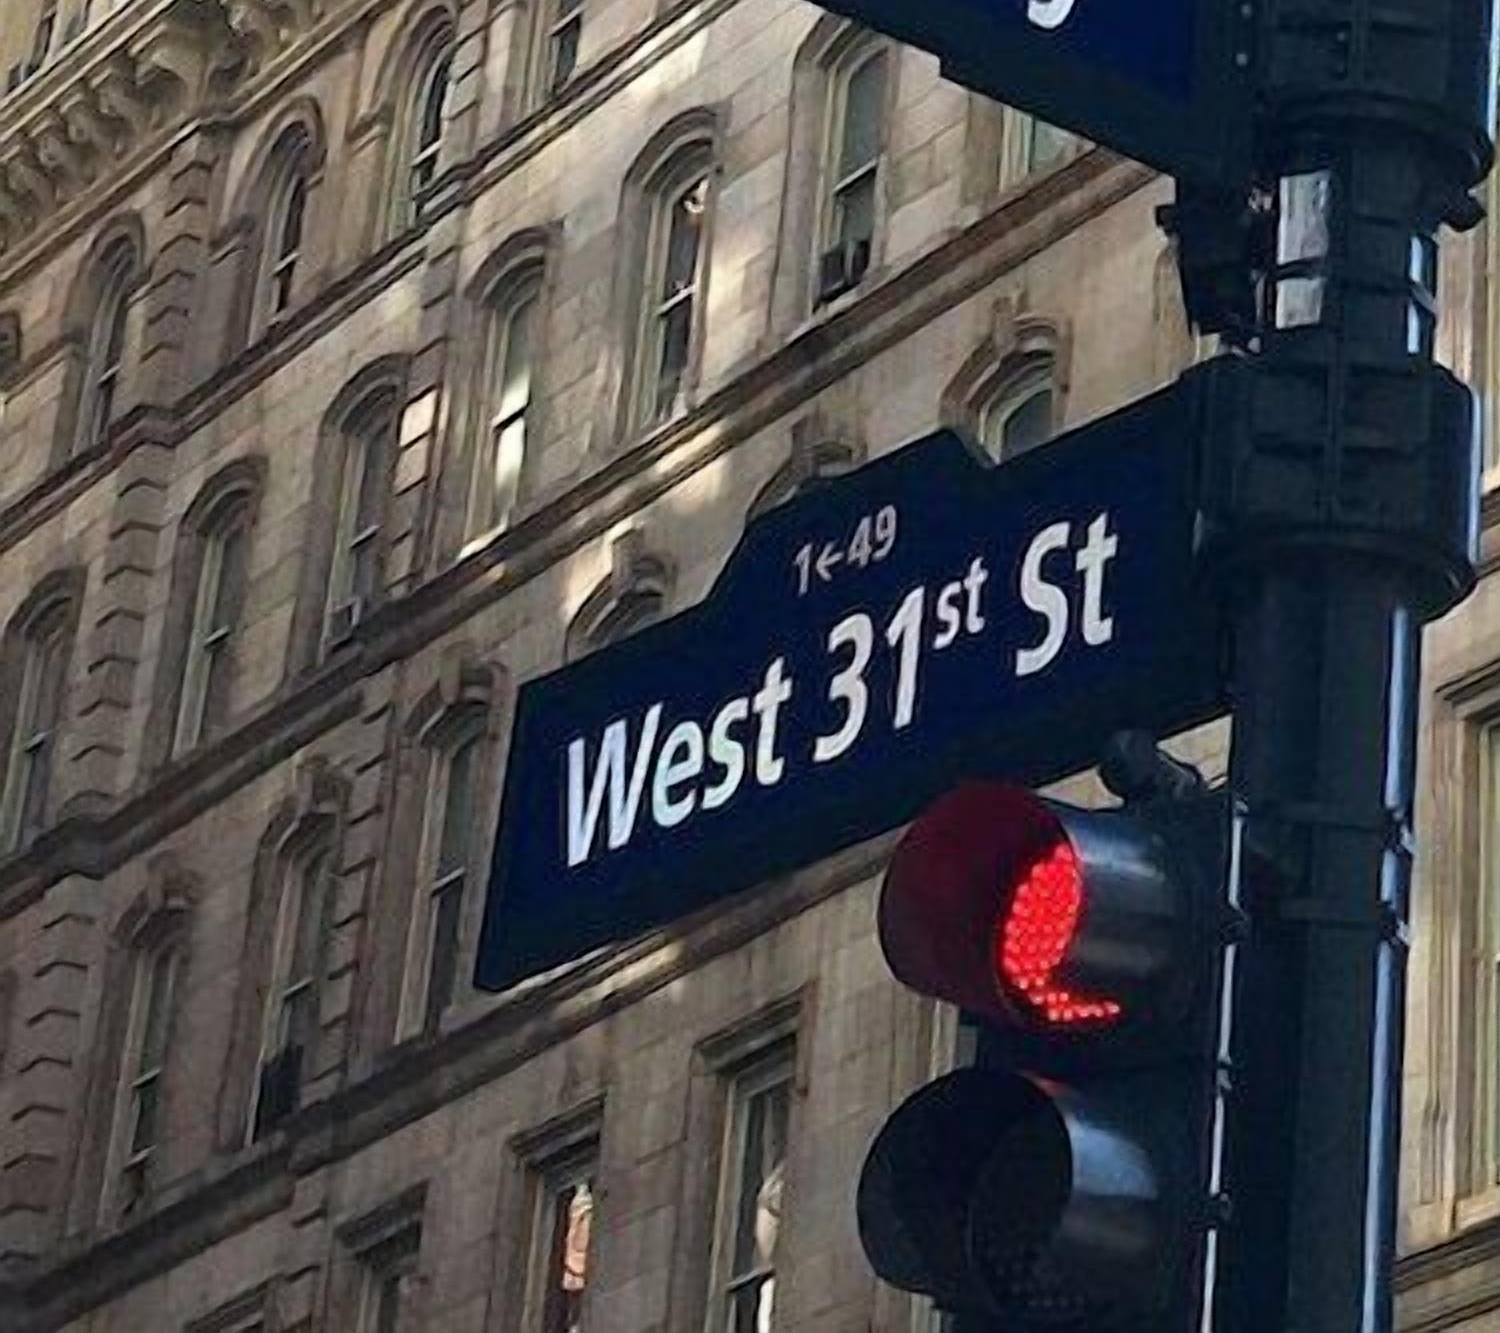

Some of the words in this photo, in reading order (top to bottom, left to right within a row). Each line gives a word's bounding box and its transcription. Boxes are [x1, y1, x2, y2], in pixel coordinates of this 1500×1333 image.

[567, 657, 793, 867] West
[813, 556, 988, 762] 31st
[1015, 512, 1118, 676] St
